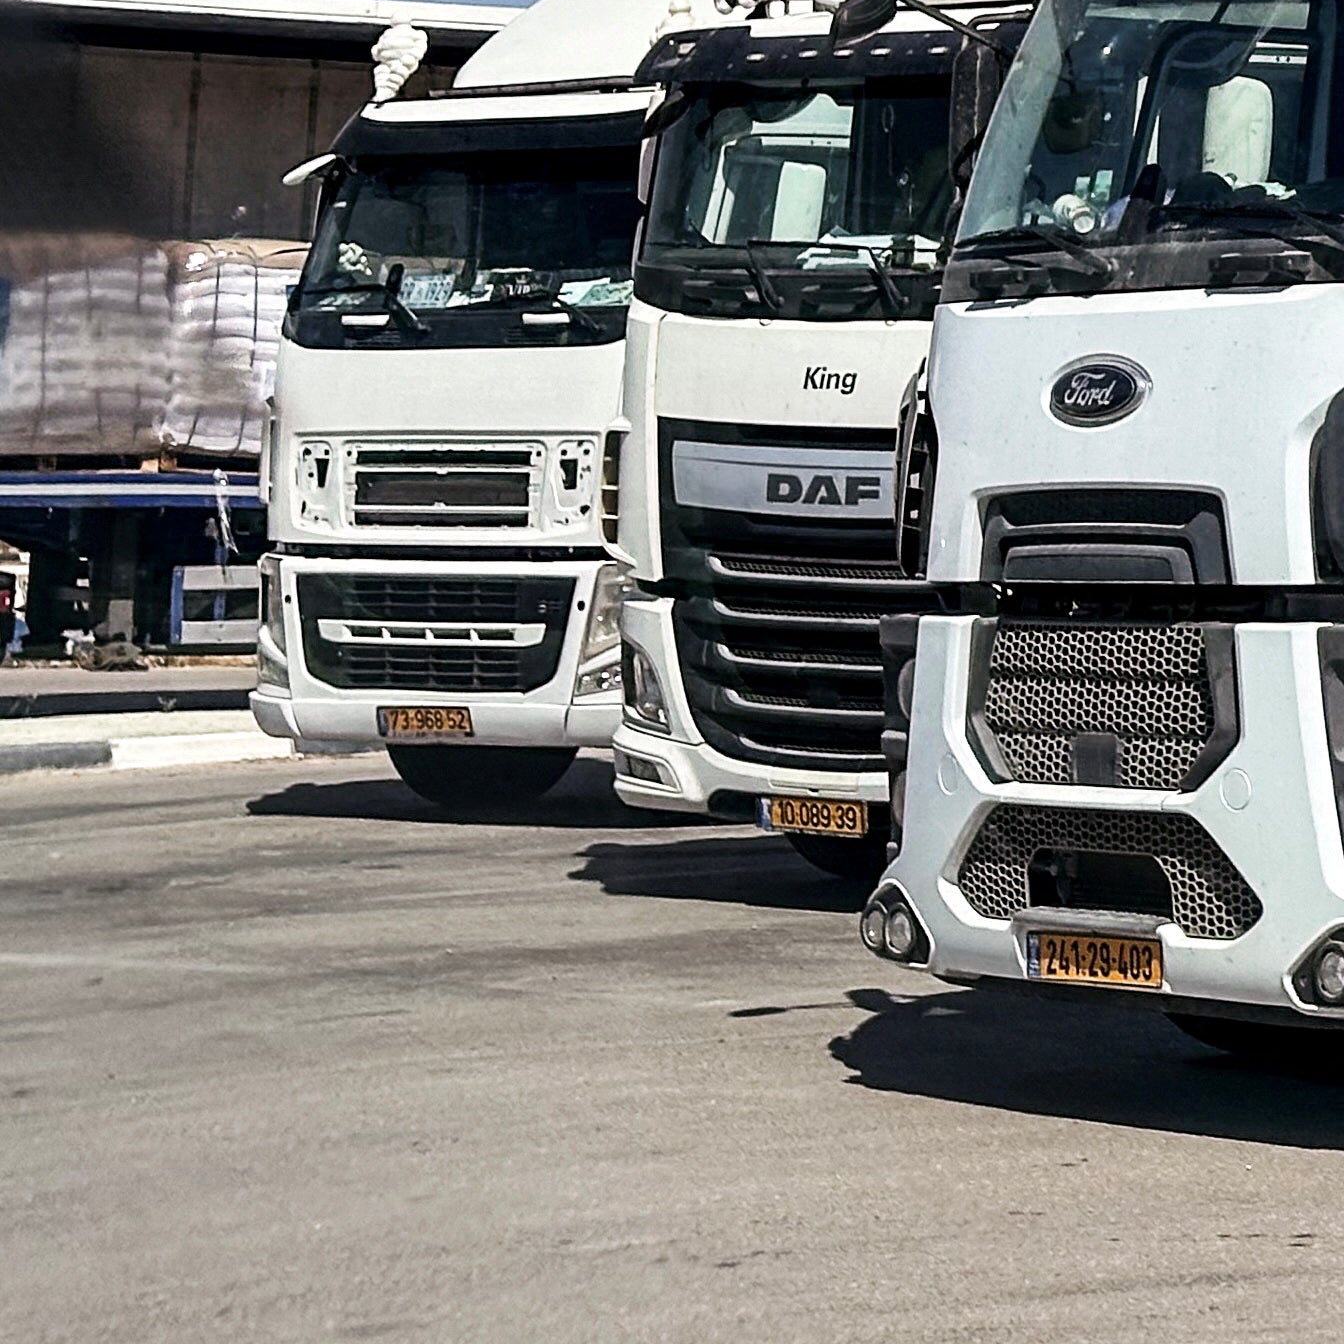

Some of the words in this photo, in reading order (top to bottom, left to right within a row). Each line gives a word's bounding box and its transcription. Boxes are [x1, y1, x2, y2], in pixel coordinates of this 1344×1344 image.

[803, 366, 858, 395] King
[1063, 371, 1118, 406] Ford
[766, 473, 881, 506] DAF
